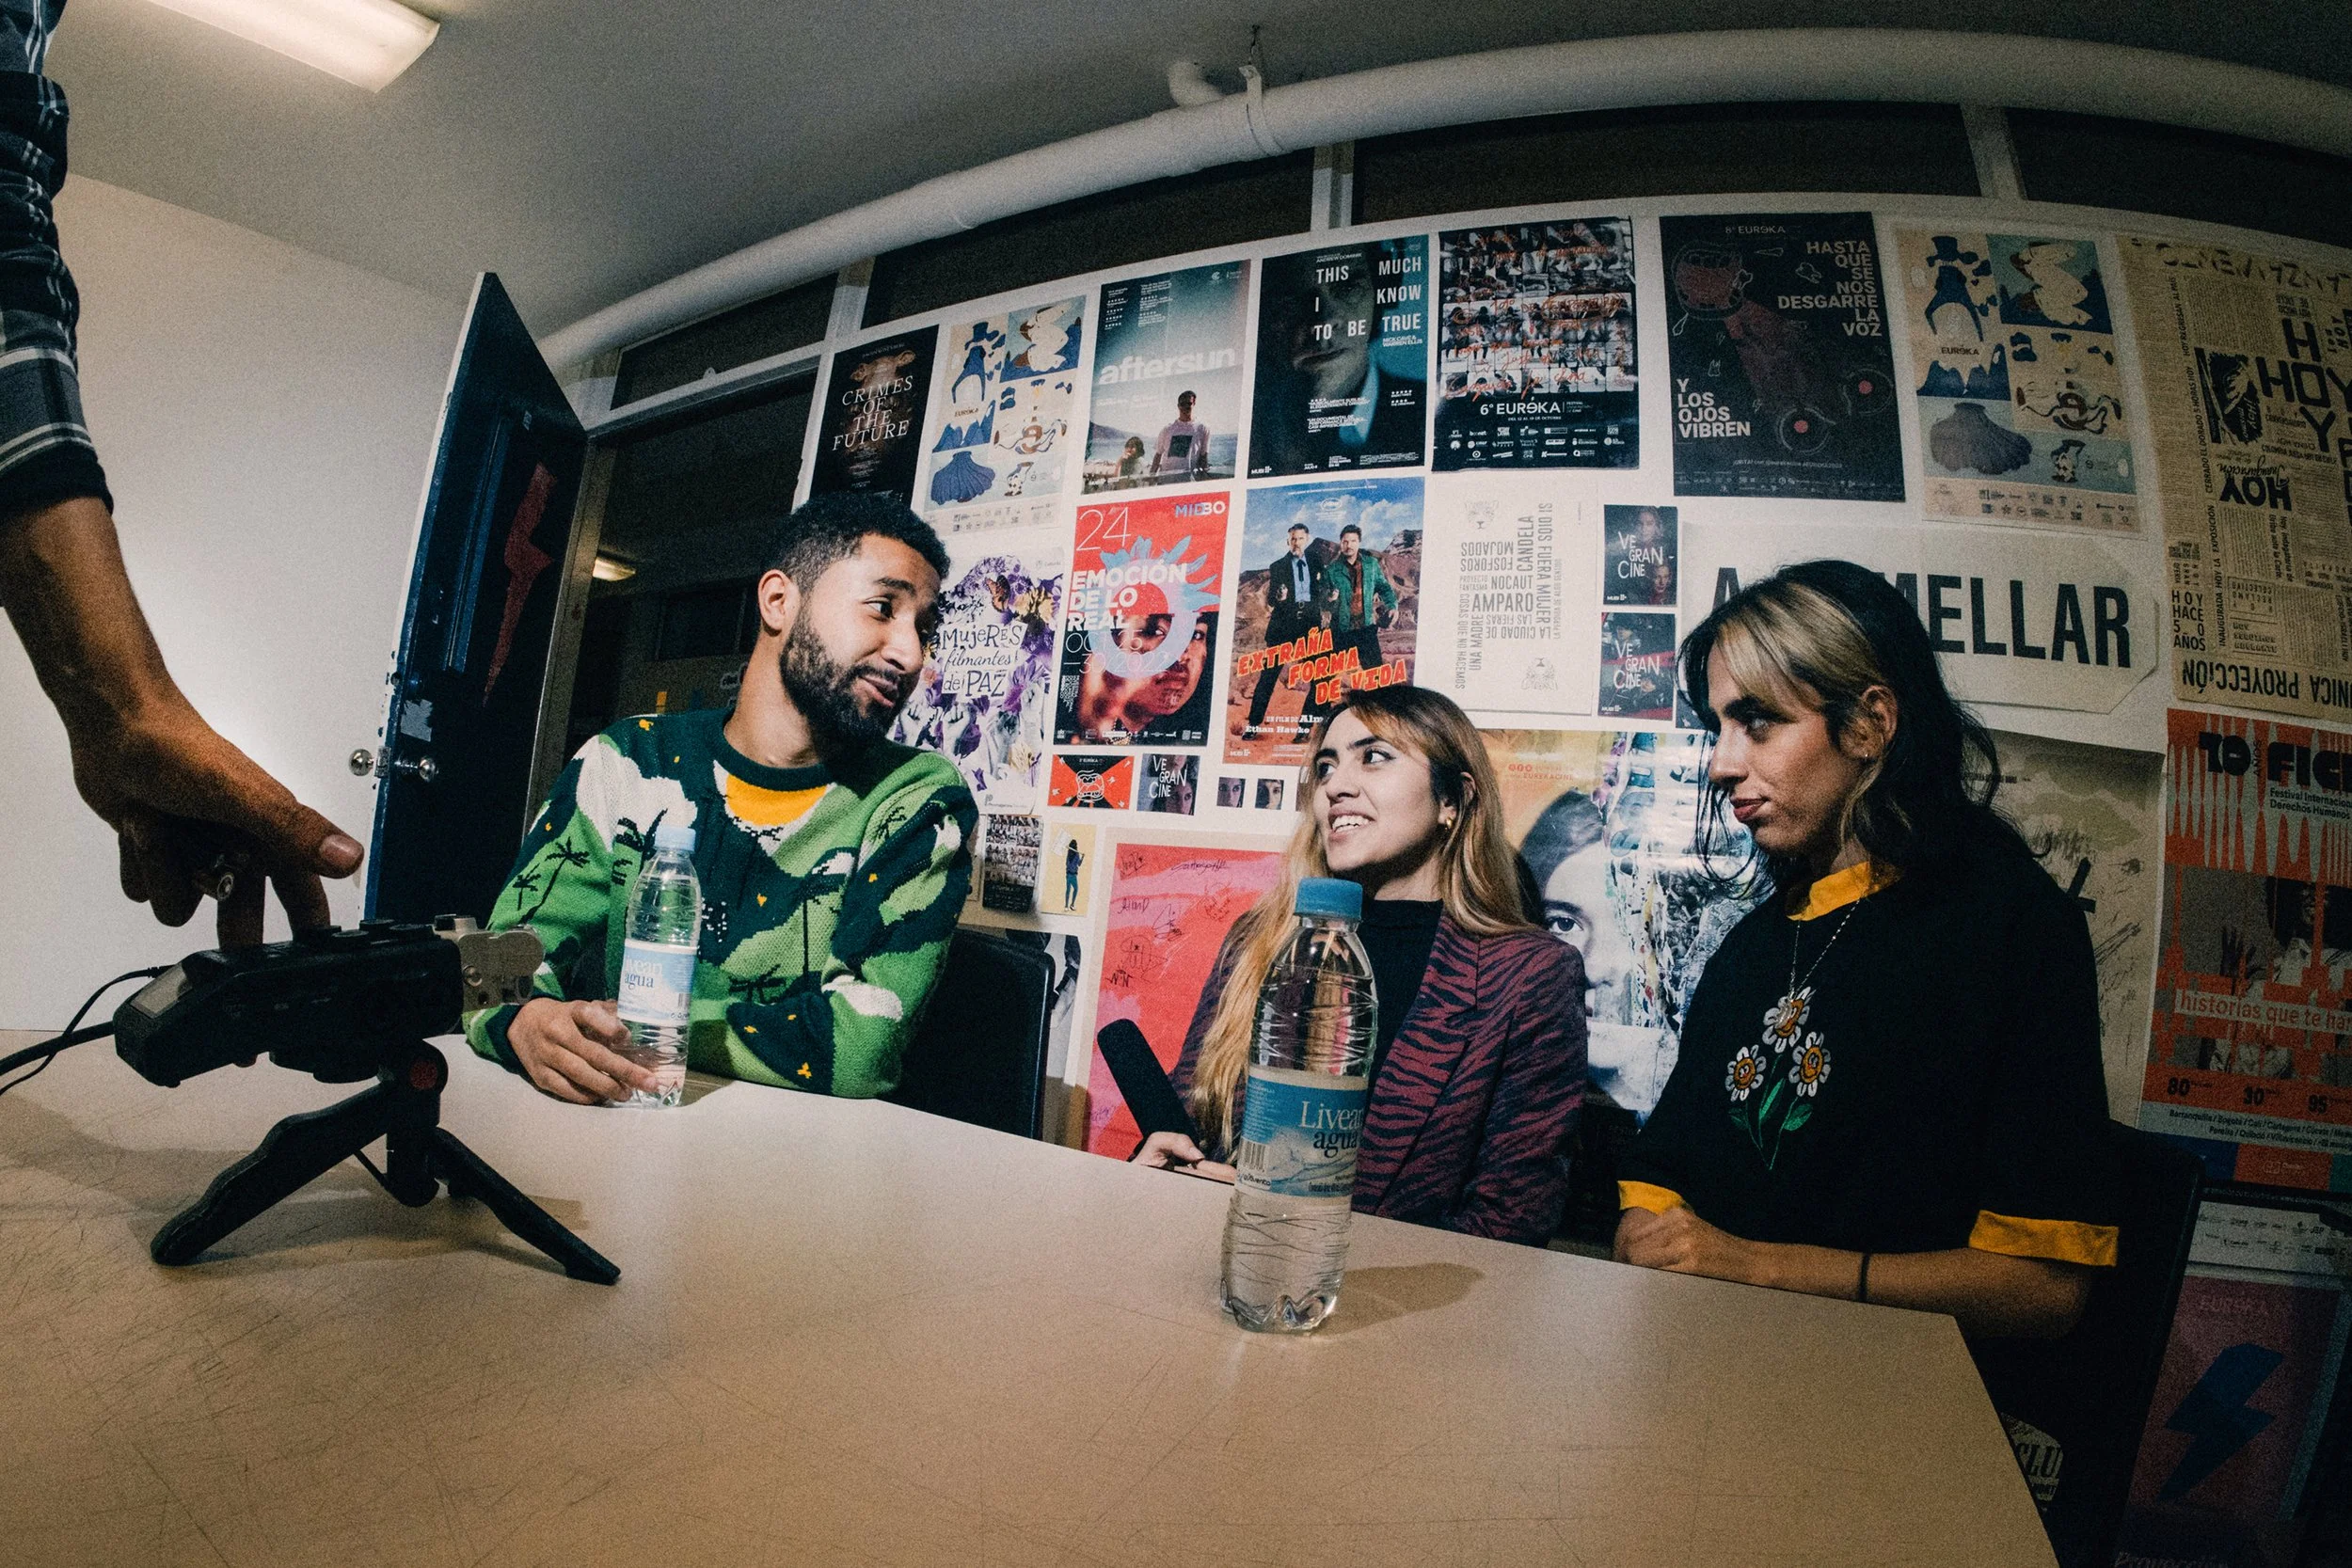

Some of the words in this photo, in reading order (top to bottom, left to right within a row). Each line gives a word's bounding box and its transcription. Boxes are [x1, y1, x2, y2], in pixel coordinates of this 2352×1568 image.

[1806, 241, 1870, 254] HASTA
[1835, 253, 1872, 266] QUE
[1316, 265, 1349, 284] THIS
[1378, 256, 1422, 276] MUCH
[1851, 267, 1874, 280] SE
[1836, 281, 1876, 294] NOS
[2174, 287, 2181, 300] AL
[1314, 296, 1320, 312] I
[1376, 284, 1422, 304] KNOW
[1778, 294, 1879, 309] DESGARRE
[1855, 309, 1880, 323] LA
[2177, 304, 2188, 341] REGRESAN
[1313, 324, 1332, 341] TO
[1347, 319, 1366, 337] BE
[1382, 313, 1422, 332] TRUE
[1842, 322, 1882, 337] VOZ
[2183, 341, 2191, 356] HOY
[1098, 347, 1236, 386] aftersun
[2186, 366, 2196, 384] HOY
[842, 375, 914, 406] CRIMES
[1677, 378, 1690, 393] Y
[1677, 391, 1714, 408] LOS
[2191, 384, 2201, 406] HORAS
[863, 397, 887, 415] OF
[1678, 406, 1731, 423] OJOS
[853, 409, 893, 432] THE
[1678, 420, 1751, 438] VIBREN
[2196, 413, 2207, 443] DORADO
[832, 420, 910, 451] FUTURE
[2201, 444, 2210, 456] EL
[2201, 457, 2213, 494] CERRADO
[2218, 474, 2293, 512] HOY
[1538, 502, 1552, 513] SI
[1075, 507, 1132, 551] 24
[1175, 500, 1226, 517] MIDBO
[1537, 516, 1552, 542] DIOS
[1460, 541, 1514, 557] MOJADOS
[1517, 515, 1534, 573] CANDELA
[1617, 531, 1636, 549] VE
[1536, 546, 1552, 580] FUERA
[1629, 546, 1663, 564] GRAN
[2214, 558, 2221, 568] LA
[1460, 557, 1513, 572] FOSFOROS
[1617, 561, 1645, 578] CINE
[1072, 560, 1187, 589] EMOCIÓN
[1459, 575, 1488, 583] PROYECTO
[1490, 575, 1534, 590] NOCAUT
[2214, 570, 2223, 589] HOY
[2285, 573, 2294, 582] de
[1459, 582, 1488, 591] FANTASMA
[2233, 582, 2272, 594] COLECTIVO
[1070, 590, 1100, 611] DE
[1104, 587, 1138, 609] LO
[1458, 594, 1470, 618] COSAS
[1471, 593, 1534, 612] AMPARO
[1535, 583, 1552, 624] MUJER
[2171, 590, 2203, 607] HOY
[2233, 592, 2272, 604] RECLAMO
[1067, 611, 1130, 631] REAL
[1486, 614, 1514, 625] FIERAS
[1516, 614, 1533, 625] LAS
[2172, 604, 2203, 621] HACE
[2215, 593, 2226, 647] INAUGURADA
[1458, 620, 1469, 635] QUE
[1470, 614, 1484, 648] MADRE
[1486, 626, 1498, 639] DE
[1501, 626, 1536, 640] CIUDAD
[1539, 626, 1551, 640] LA
[1457, 637, 1468, 649] NO
[1614, 641, 1633, 658] VE
[2173, 632, 2206, 651] AÑOS
[944, 649, 1011, 672] filmantes
[1236, 626, 1334, 677] EXTRAÑA
[1288, 647, 1359, 689] FORMA
[1454, 650, 1468, 689] HACEMOS
[1469, 651, 1483, 671] UNA
[1625, 656, 1661, 674] GRAN
[965, 670, 1007, 697] PAZ
[1315, 680, 1343, 705] DE
[1350, 658, 1407, 691] VIDA
[1613, 670, 1642, 689] CINE
[2182, 659, 2299, 699] PROYECCIÓN
[1245, 725, 1274, 734] Ethan
[1276, 725, 1311, 734] Hawke
[2200, 732, 2251, 776] 10
[1153, 755, 1167, 773] VE
[1158, 764, 1187, 787] GRAN
[1149, 781, 1171, 800] CINE
[2269, 787, 2303, 800] Festival
[2269, 799, 2311, 814] Derechos
[2312, 804, 2350, 820] Humanos
[624, 972, 654, 990] agua
[2181, 993, 2261, 1019] historias
[2265, 1006, 2298, 1025] que
[2304, 1009, 2321, 1026] te
[2168, 1077, 2190, 1096] 80
[2243, 1085, 2265, 1105] 30
[2308, 1094, 2328, 1115] 95
[2169, 1108, 2213, 1121] Barranquilla
[1313, 1130, 1358, 1159] agua
